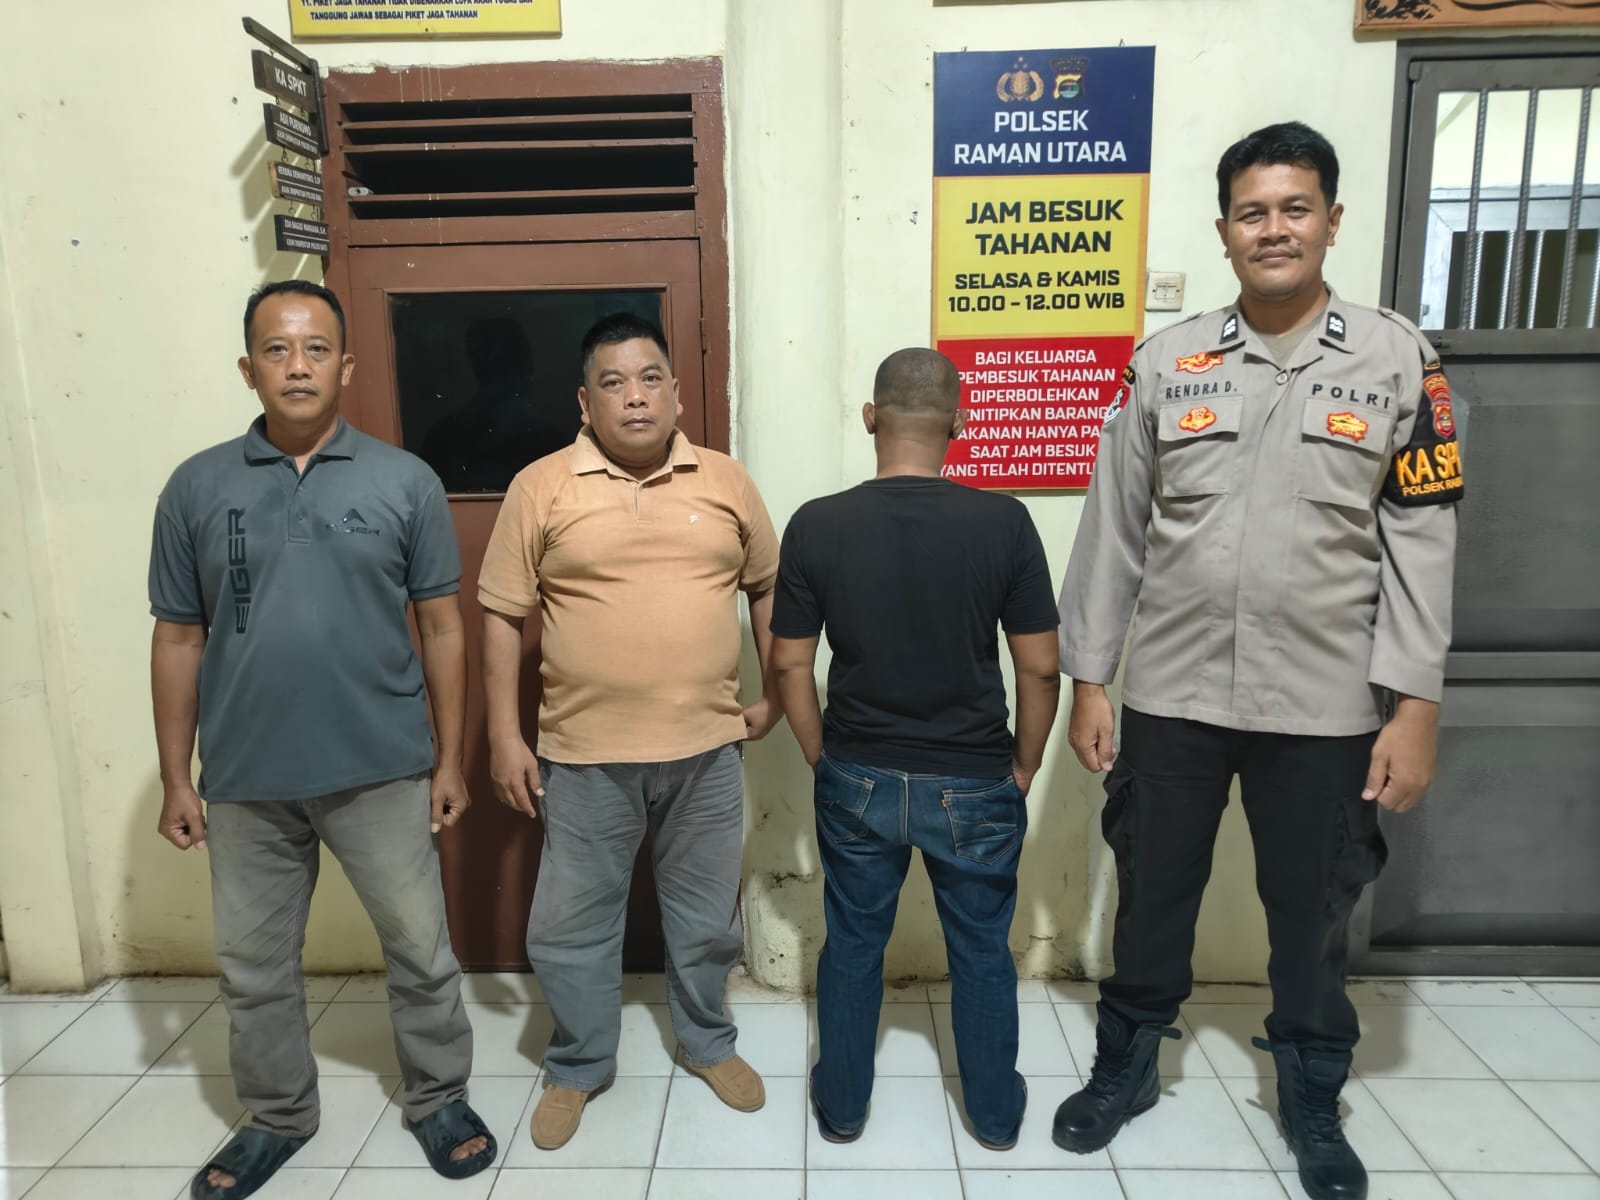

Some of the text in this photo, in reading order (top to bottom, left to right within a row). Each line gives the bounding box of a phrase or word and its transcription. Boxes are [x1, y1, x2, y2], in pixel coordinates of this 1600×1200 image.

[310, 10, 478, 20] TANGGUNG JAWAB SEBAGAI PIKET JAGA TAHANAN
[275, 66, 307, 97] KA SPKT
[994, 110, 1089, 133] POLSEK
[954, 141, 1127, 164] RAMAN UTARA
[965, 199, 1124, 225] JAM BESUK
[975, 231, 1111, 256] TAHANAN
[955, 270, 1120, 290] SELASA & KAMIS
[949, 295, 1005, 312] 10.00
[1025, 293, 1080, 311] 12.00
[1085, 292, 1125, 309] WIB
[975, 349, 1097, 365] BAGI KELUARGA
[958, 369, 1040, 385] PEMBESUK
[1041, 368, 1116, 382] TAHANAN
[970, 387, 1100, 403] DIPERBOLEHKAN
[1166, 381, 1238, 399] RENDRA D.
[1311, 383, 1390, 409] POLRI
[966, 406, 1107, 422] NITIPKAN BARANG
[957, 424, 1100, 440] AKANAN HANYA PA
[970, 443, 1096, 459] SAAT JAM BESUK
[940, 462, 1095, 477] YANG TELAH DITENTU
[1396, 441, 1463, 486] KA SP
[1402, 480, 1446, 497] POLSEK
[228, 507, 251, 634] EIGER
